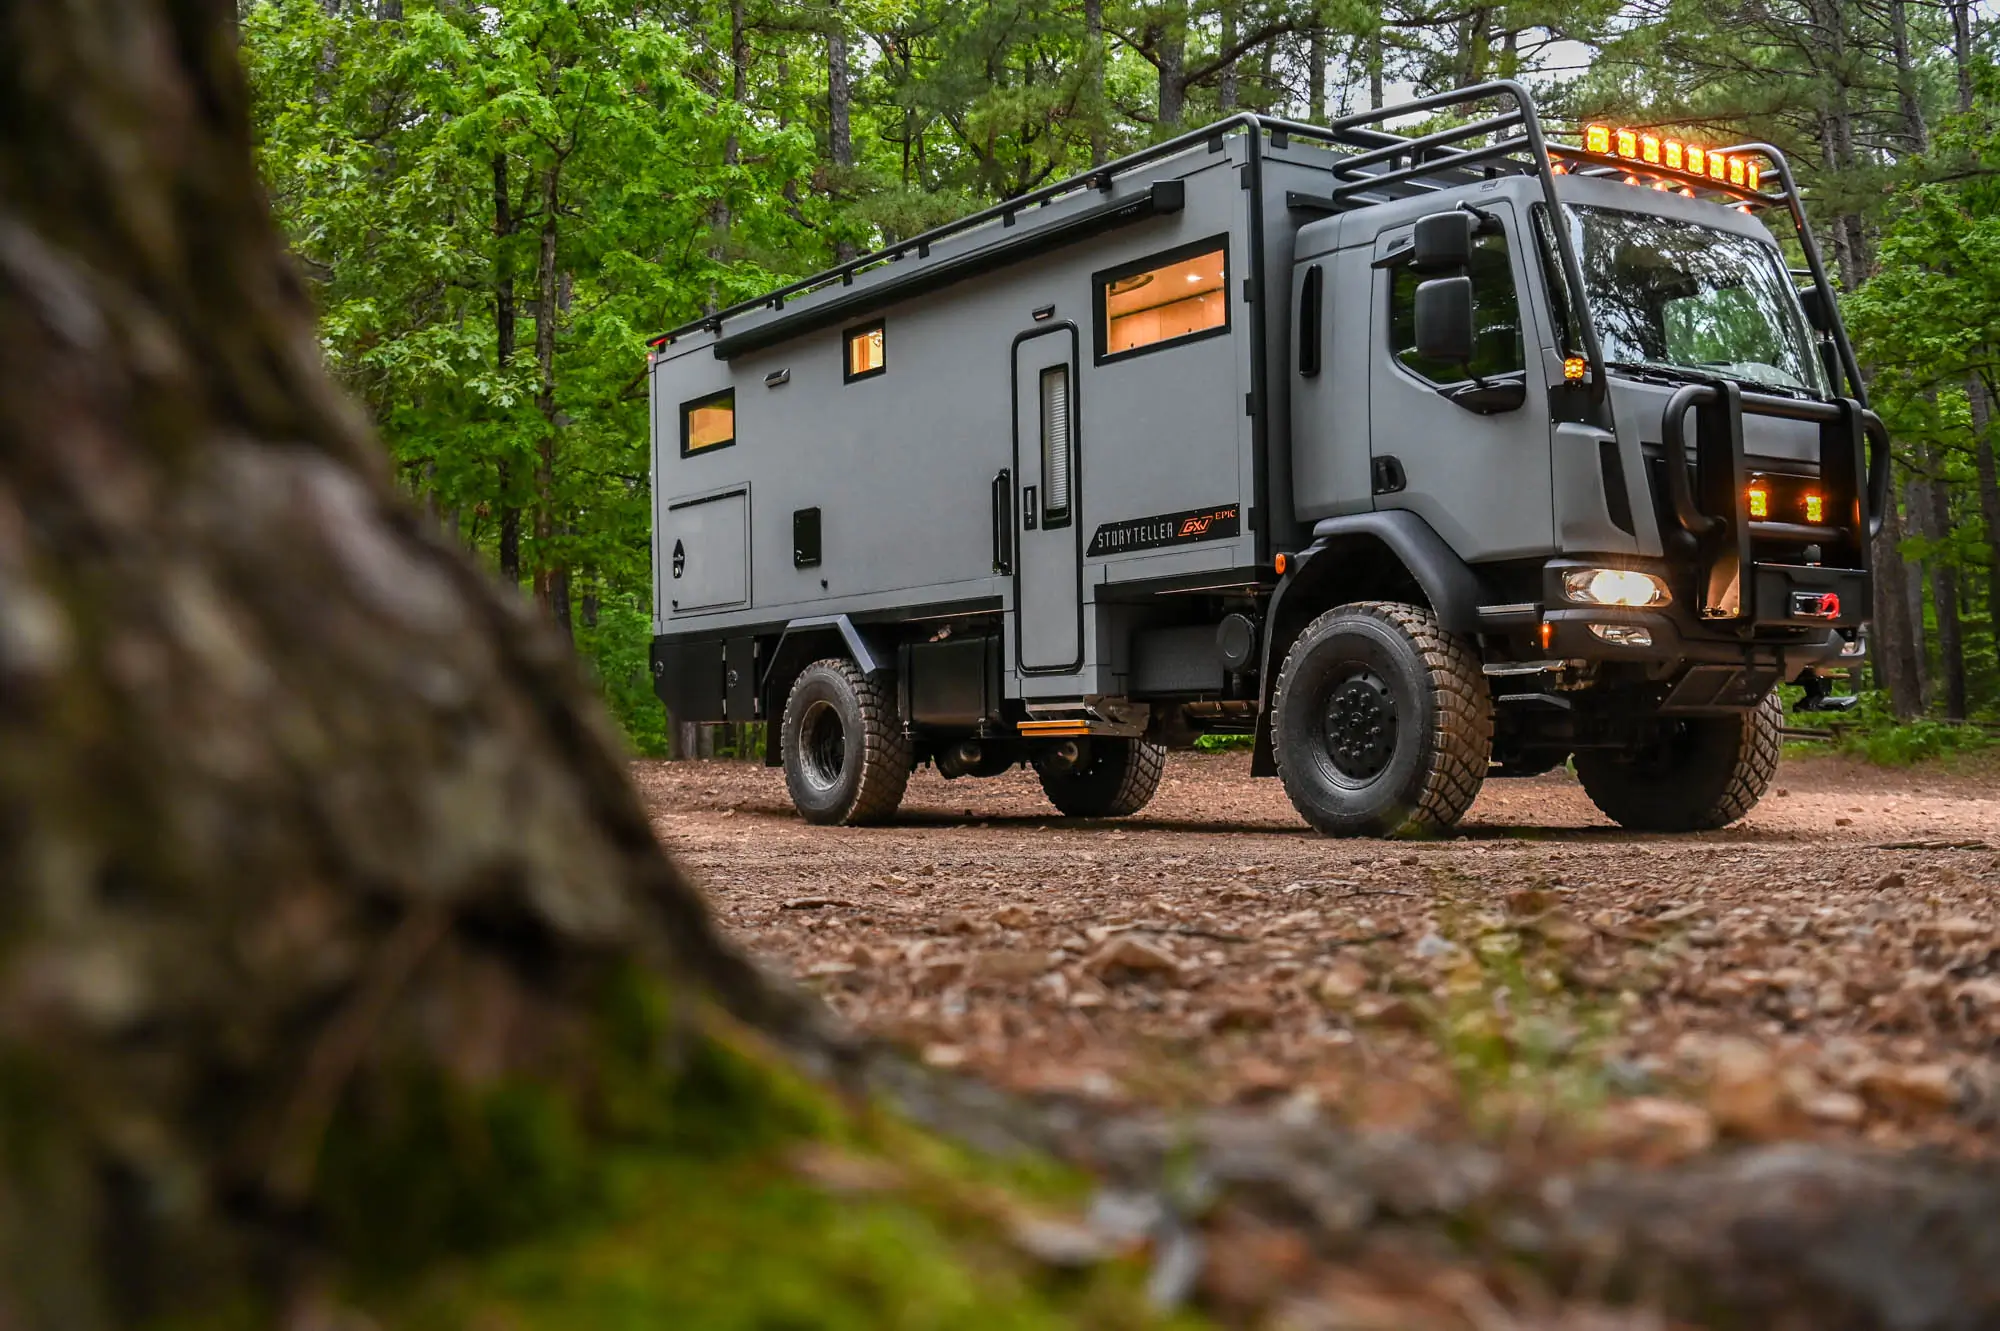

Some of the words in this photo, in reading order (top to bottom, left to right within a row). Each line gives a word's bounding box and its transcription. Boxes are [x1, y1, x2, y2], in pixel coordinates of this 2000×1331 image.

[1098, 522, 1173, 548] STORYTELLER
[1181, 518, 1210, 534] GXV
[1215, 509, 1236, 520] EPIC
